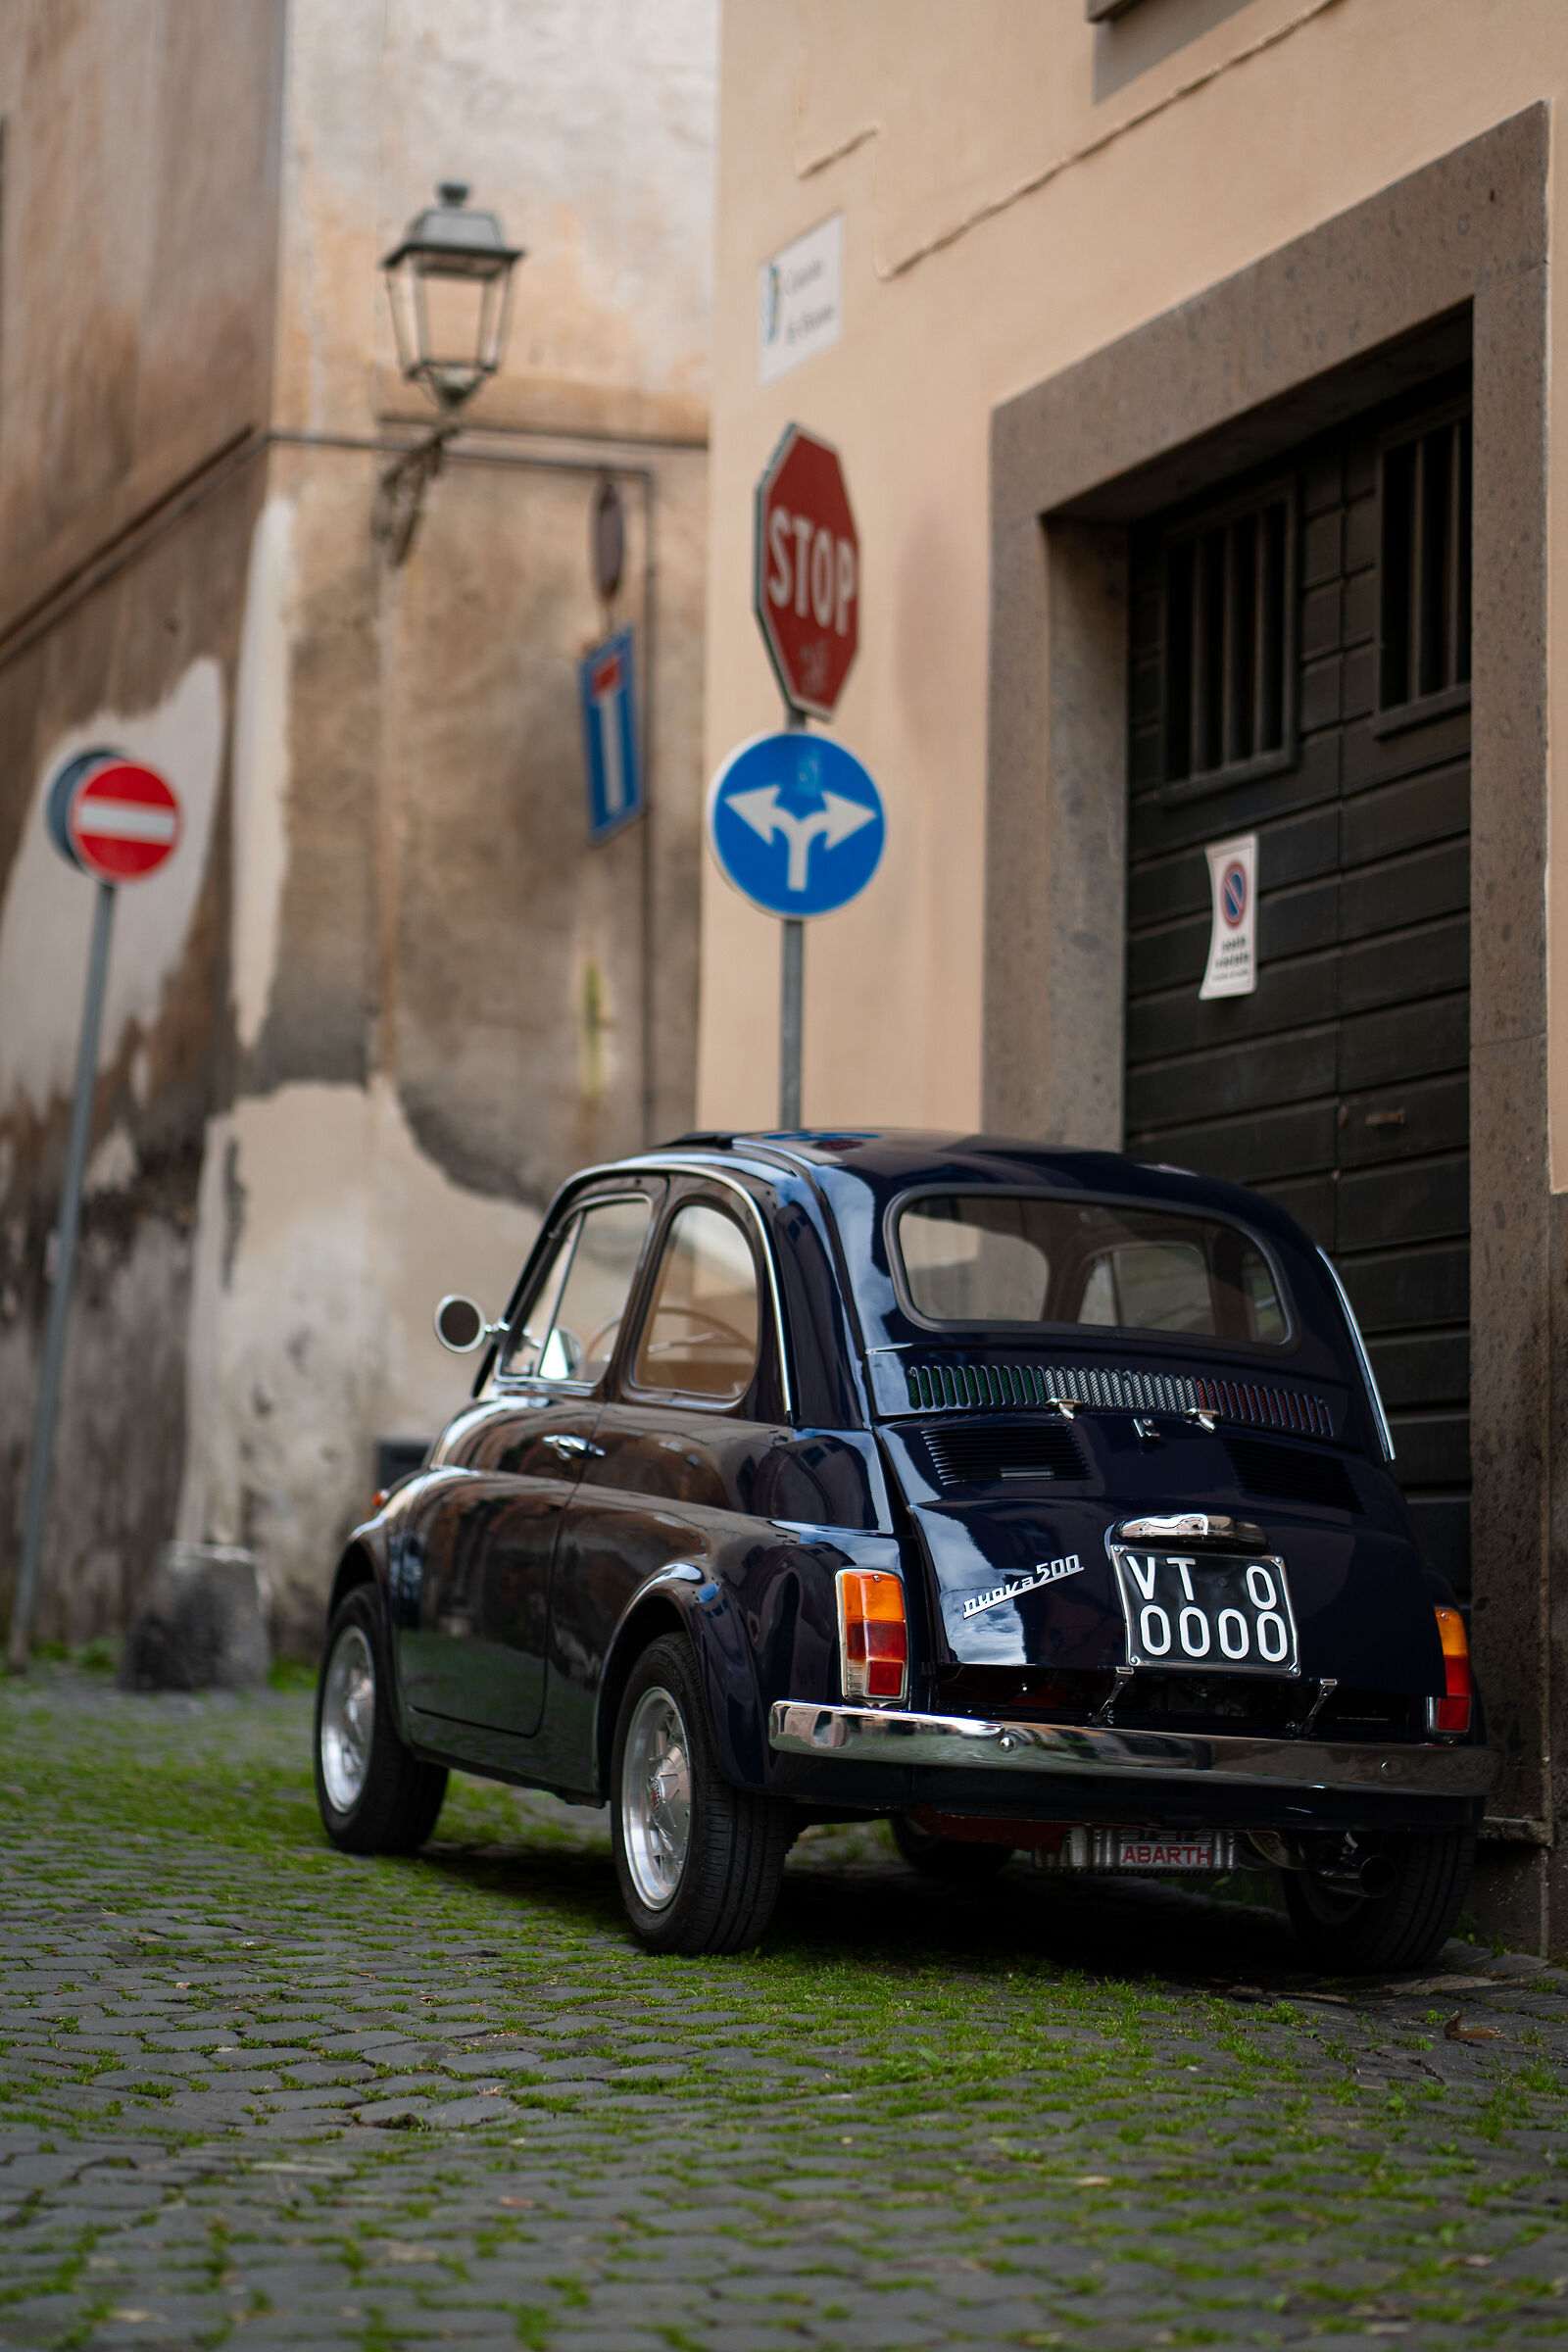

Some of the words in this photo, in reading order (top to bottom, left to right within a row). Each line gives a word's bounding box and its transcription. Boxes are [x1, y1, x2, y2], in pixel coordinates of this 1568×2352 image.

[769, 508, 856, 636] STOP
[1126, 1555, 1196, 1601] VT
[1140, 1604, 1288, 1662] 0000
[1121, 1845, 1211, 1864] ABARTH
